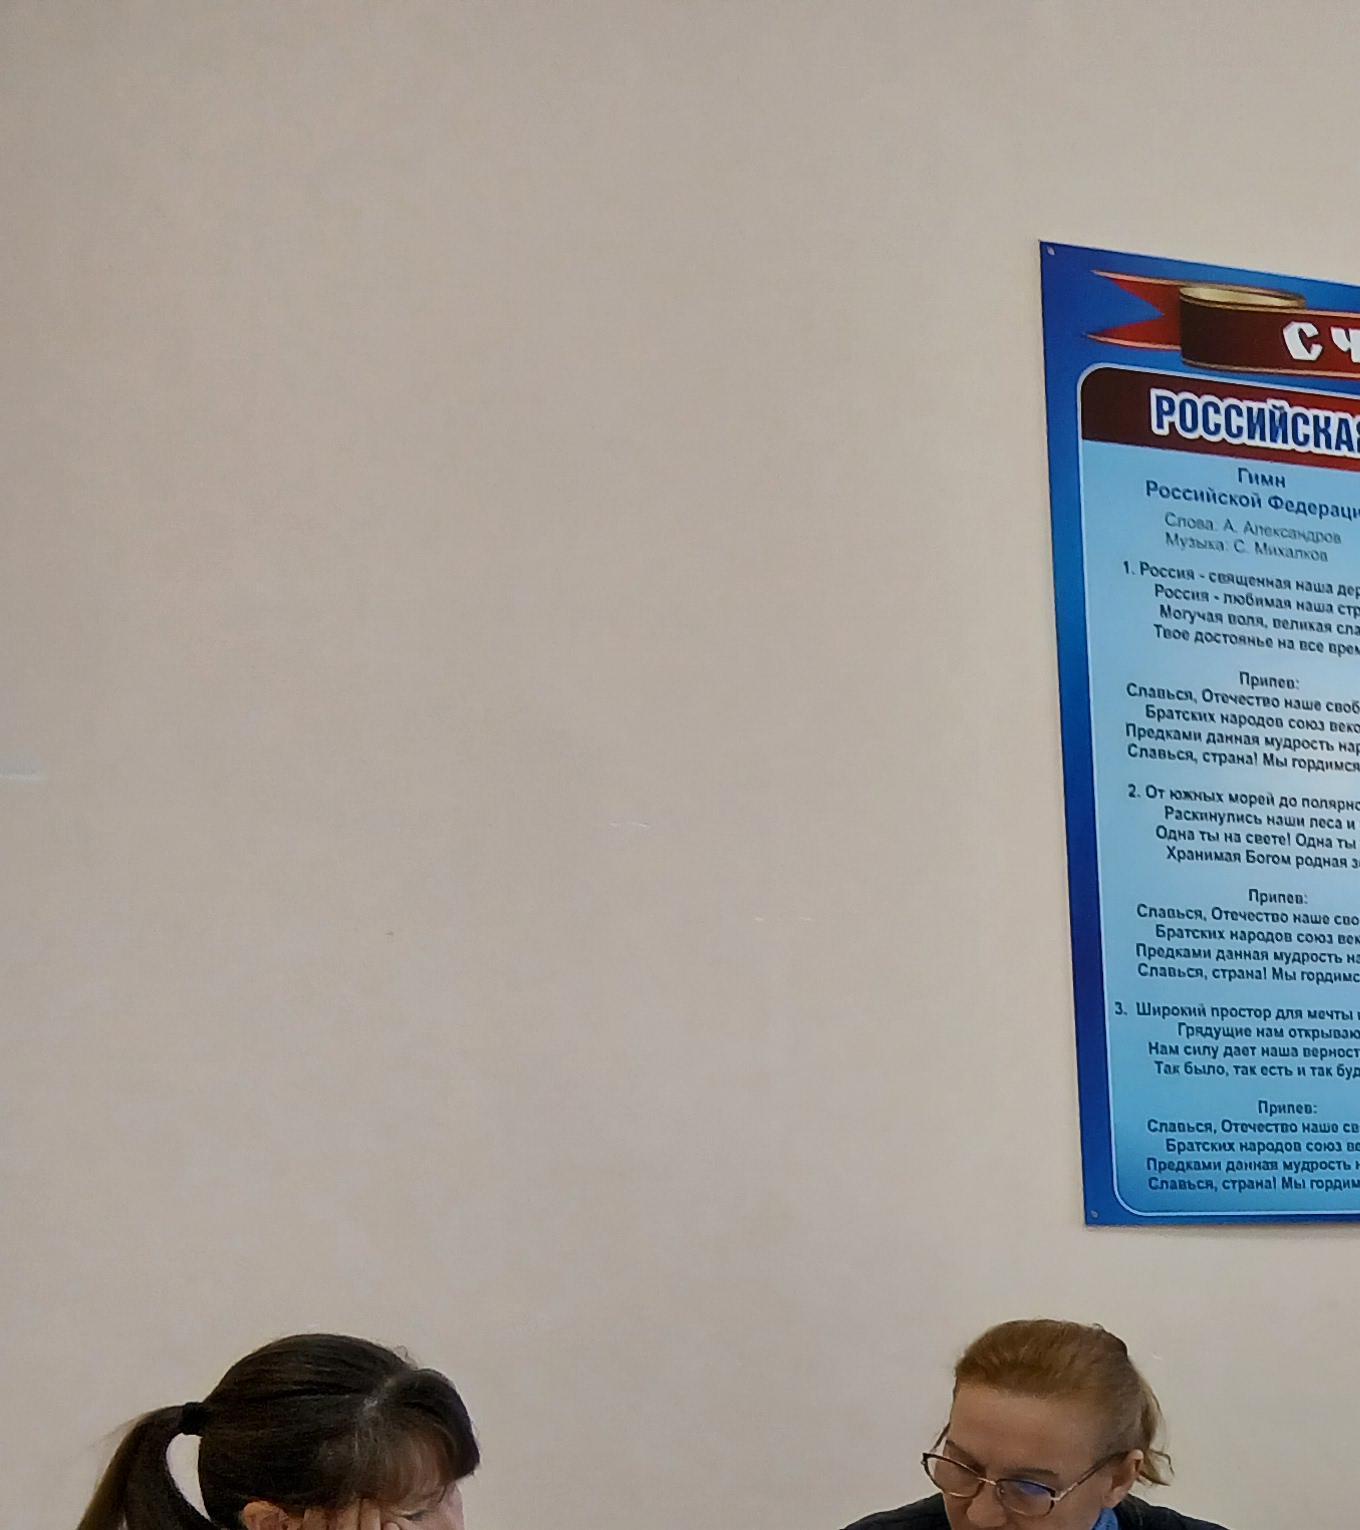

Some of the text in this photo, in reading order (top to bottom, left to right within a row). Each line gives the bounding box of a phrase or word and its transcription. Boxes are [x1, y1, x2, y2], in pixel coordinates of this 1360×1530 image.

[1283, 321, 1323, 363] С
[1236, 466, 1286, 489] Гимн
[1144, 478, 1262, 509] Российской
[1138, 559, 1195, 581] Россия
[1207, 570, 1292, 590] священная
[1294, 579, 1334, 594] наша
[1153, 582, 1210, 602] Россия
[1222, 591, 1292, 610] любимая
[1294, 599, 1334, 614] наша
[1158, 603, 1224, 625] Могучая
[1271, 616, 1333, 634] великая
[1152, 622, 1190, 641] Твое
[1192, 629, 1274, 648] достоянье
[1276, 637, 1295, 651] на
[1298, 639, 1324, 654] все
[1144, 783, 1166, 799] От
[1168, 788, 1224, 803] южных
[1227, 791, 1275, 809] морей
[1277, 795, 1298, 809] до
[1163, 804, 1263, 827] Раскинулись
[1265, 813, 1305, 828] наши
[1308, 816, 1343, 830] леса
[1345, 818, 1356, 831] и
[1154, 823, 1195, 842] Одна
[1197, 829, 1220, 842] ты
[1222, 831, 1242, 844] на
[1244, 830, 1291, 846] свете!
[1294, 831, 1333, 850] Одна
[1335, 836, 1357, 850] ты
[1165, 844, 1242, 863] Хранимая
[1244, 848, 1292, 866] Богом
[1294, 854, 1348, 870] родная
[1134, 1000, 1207, 1020] Широкий
[1209, 1005, 1272, 1022] простор
[1274, 1007, 1303, 1021] для
[1306, 1008, 1354, 1021] мечты
[1176, 1020, 1252, 1041] Грядущие
[1254, 1026, 1285, 1038] нам
[1147, 1040, 1180, 1056] Нам
[1182, 1043, 1220, 1060] силу
[1221, 1044, 1257, 1059] дает
[1260, 1045, 1299, 1058] наша
[1152, 1059, 1180, 1075] Так
[1231, 1064, 1258, 1076] так
[1259, 1064, 1294, 1077] есть
[1295, 1065, 1307, 1077] и
[1308, 1065, 1333, 1077] так
[1220, 1118, 1299, 1134] Отечество
[1300, 1121, 1339, 1134] наше
[1164, 1136, 1236, 1156] Братских
[1237, 1140, 1302, 1156] народов
[1304, 1140, 1343, 1153] союз
[1145, 1156, 1222, 1174] Предками
[1224, 1158, 1279, 1174] данная
[1281, 1159, 1352, 1174] мудрость
[1220, 1174, 1277, 1194] страна!
[1280, 1174, 1306, 1190] Мы
